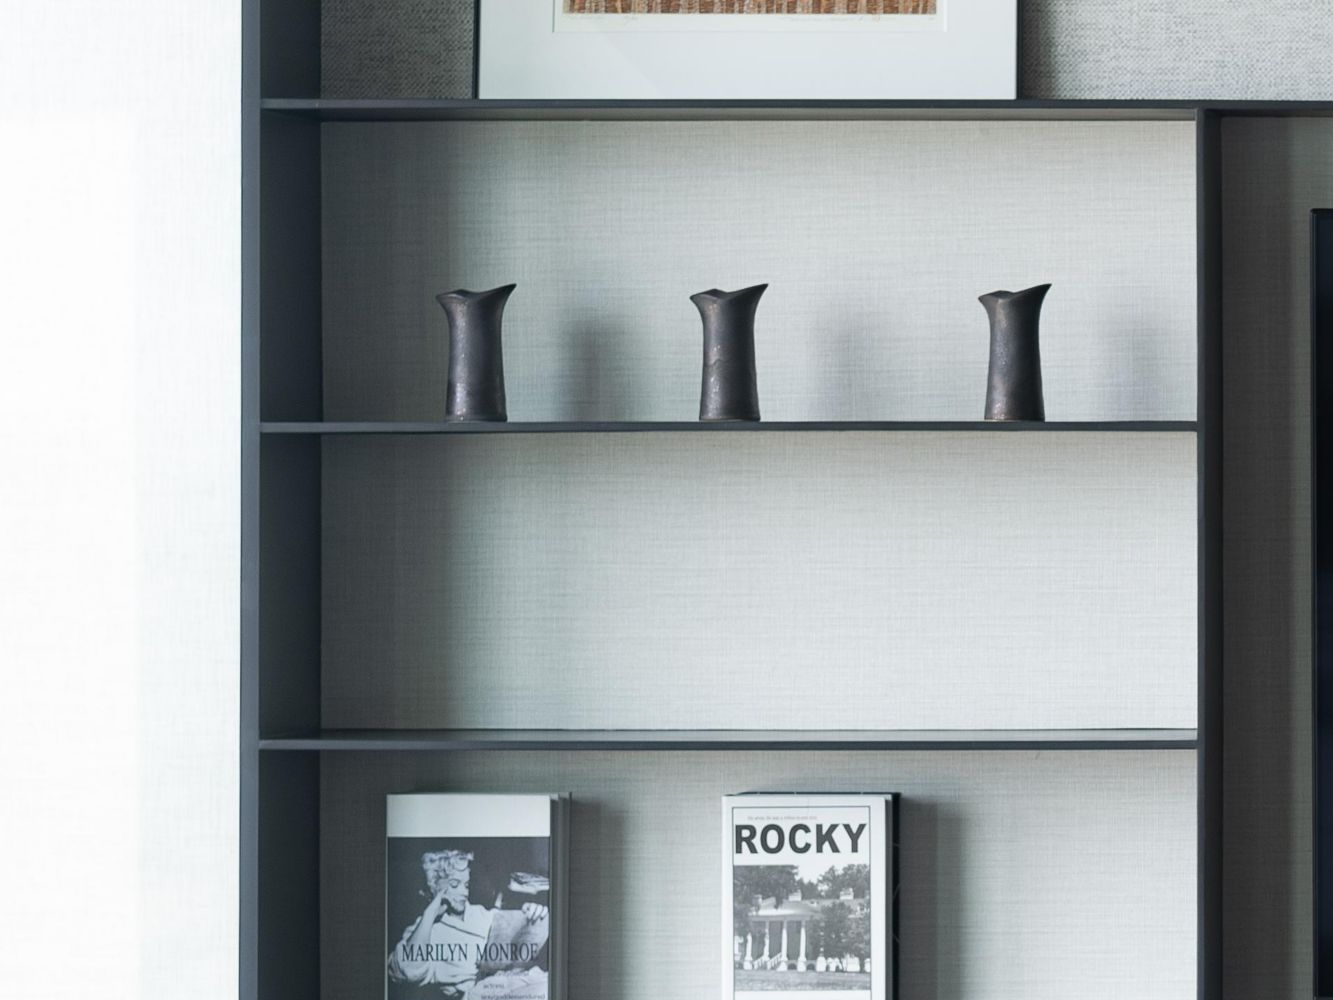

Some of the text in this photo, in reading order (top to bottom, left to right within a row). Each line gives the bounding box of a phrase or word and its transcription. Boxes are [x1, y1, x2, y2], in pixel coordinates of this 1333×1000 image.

[734, 822, 867, 855] ROCKY
[402, 942, 537, 962] MARILYN MONROE
